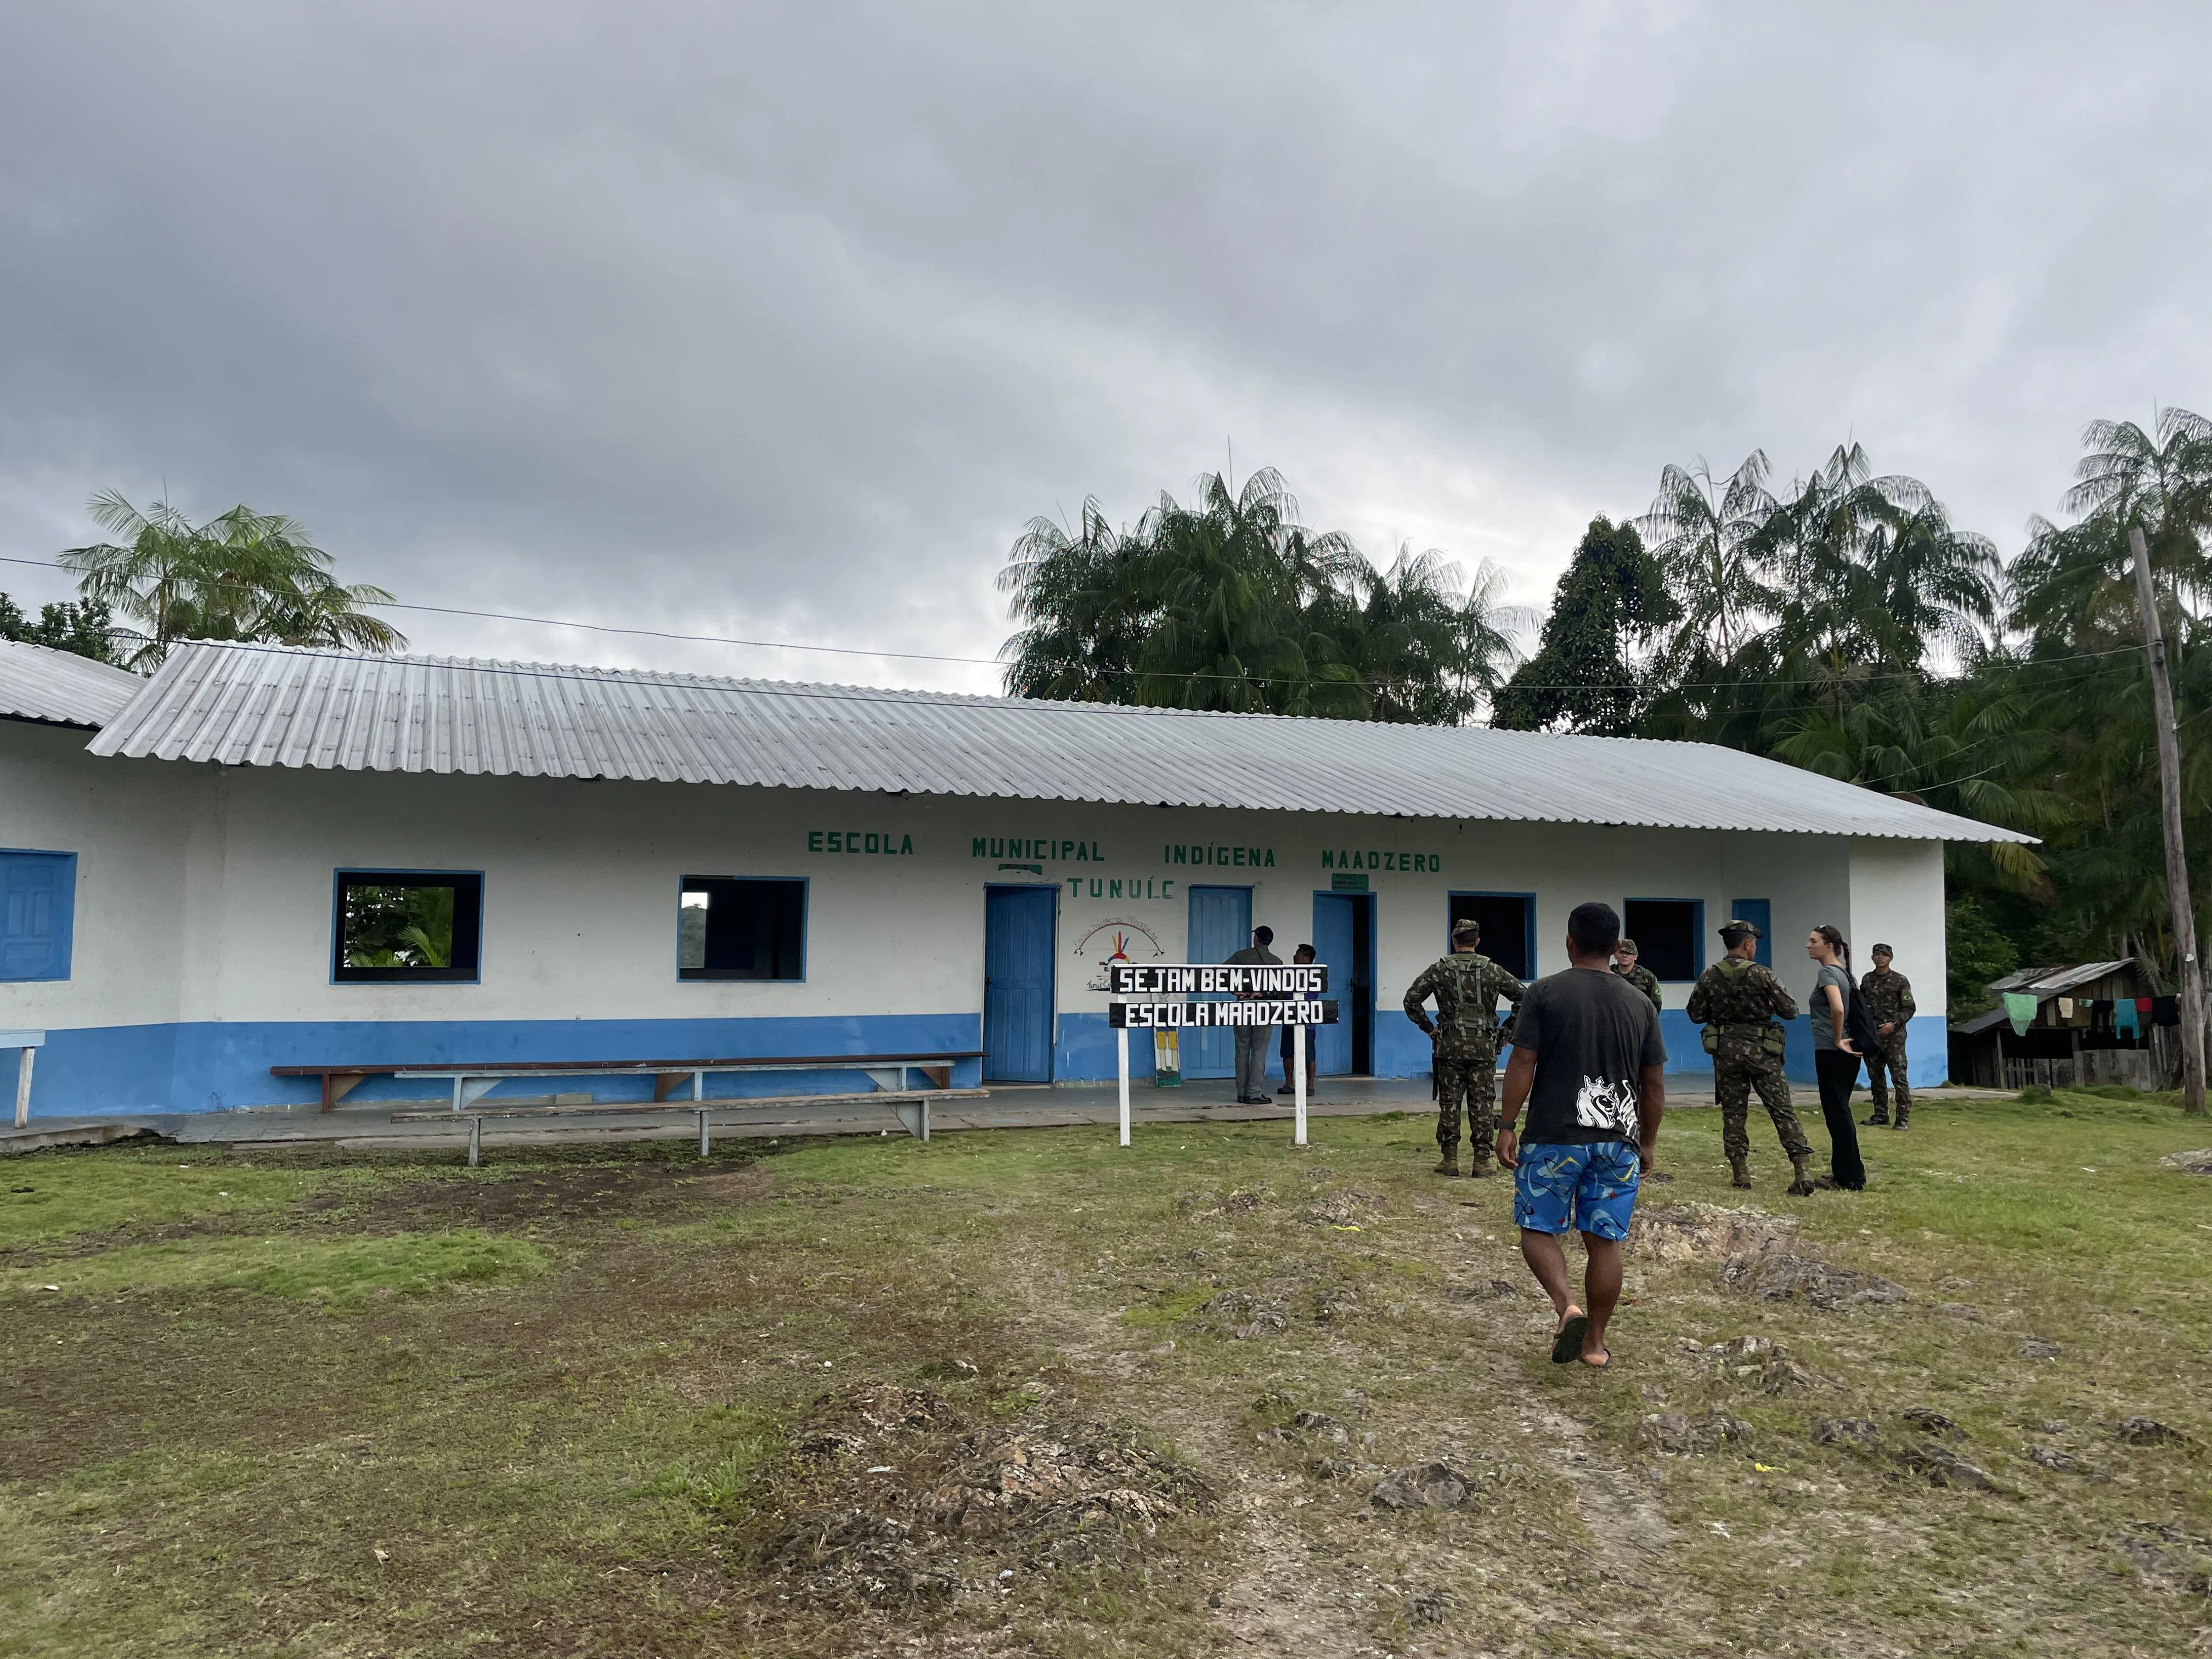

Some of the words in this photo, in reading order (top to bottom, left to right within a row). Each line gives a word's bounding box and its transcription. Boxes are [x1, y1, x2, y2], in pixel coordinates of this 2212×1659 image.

[808, 831, 913, 855] ESCOLA
[972, 837, 1105, 861] MUNICIPAL
[1165, 842, 1276, 867] INDÍGENA
[1322, 850, 1440, 872] MAADZERO
[1119, 968, 1195, 992] SEJAM
[1201, 968, 1322, 992] BEM-VINDOS
[1125, 1002, 1209, 1028] ESCOLA
[1215, 1000, 1323, 1026] MAADZERO
